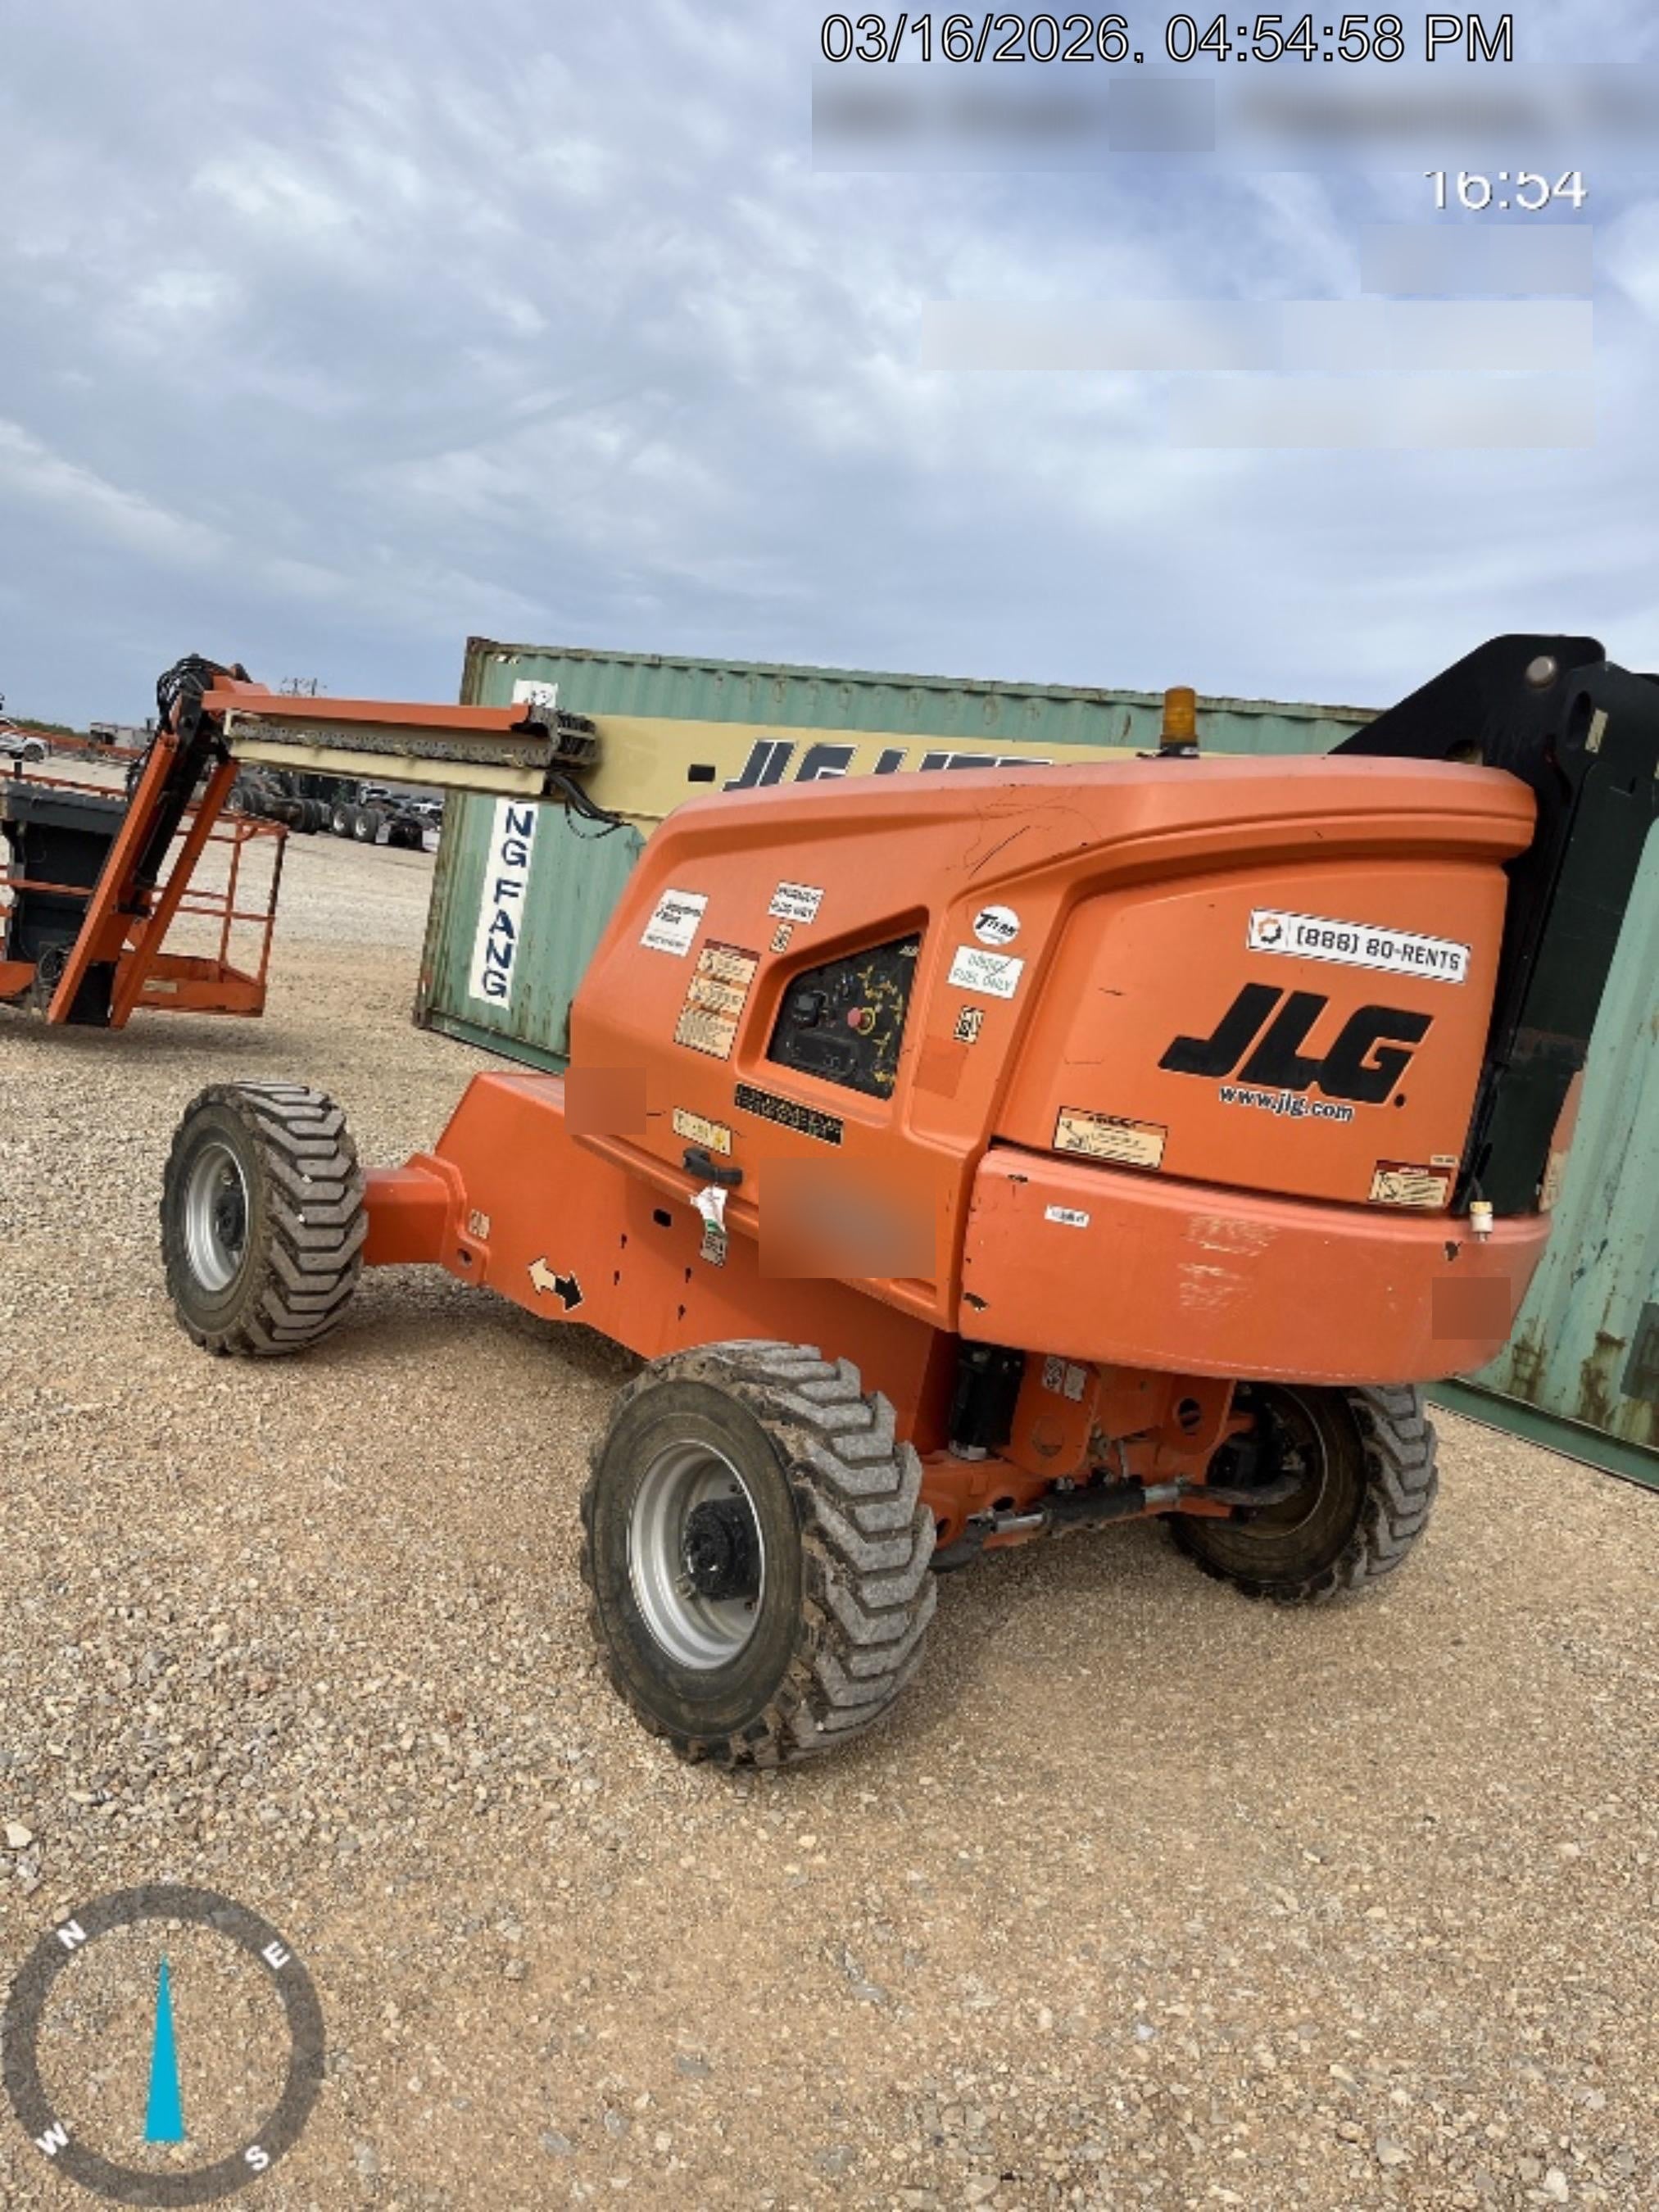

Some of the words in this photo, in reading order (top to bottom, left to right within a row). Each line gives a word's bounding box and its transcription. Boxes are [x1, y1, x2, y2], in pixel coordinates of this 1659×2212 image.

[482, 877, 523, 999] FANG
[1296, 925, 1360, 954] (888)
[1366, 937, 1462, 971] 80-RENTS
[1219, 1086, 1353, 1122] www.jlg.com
